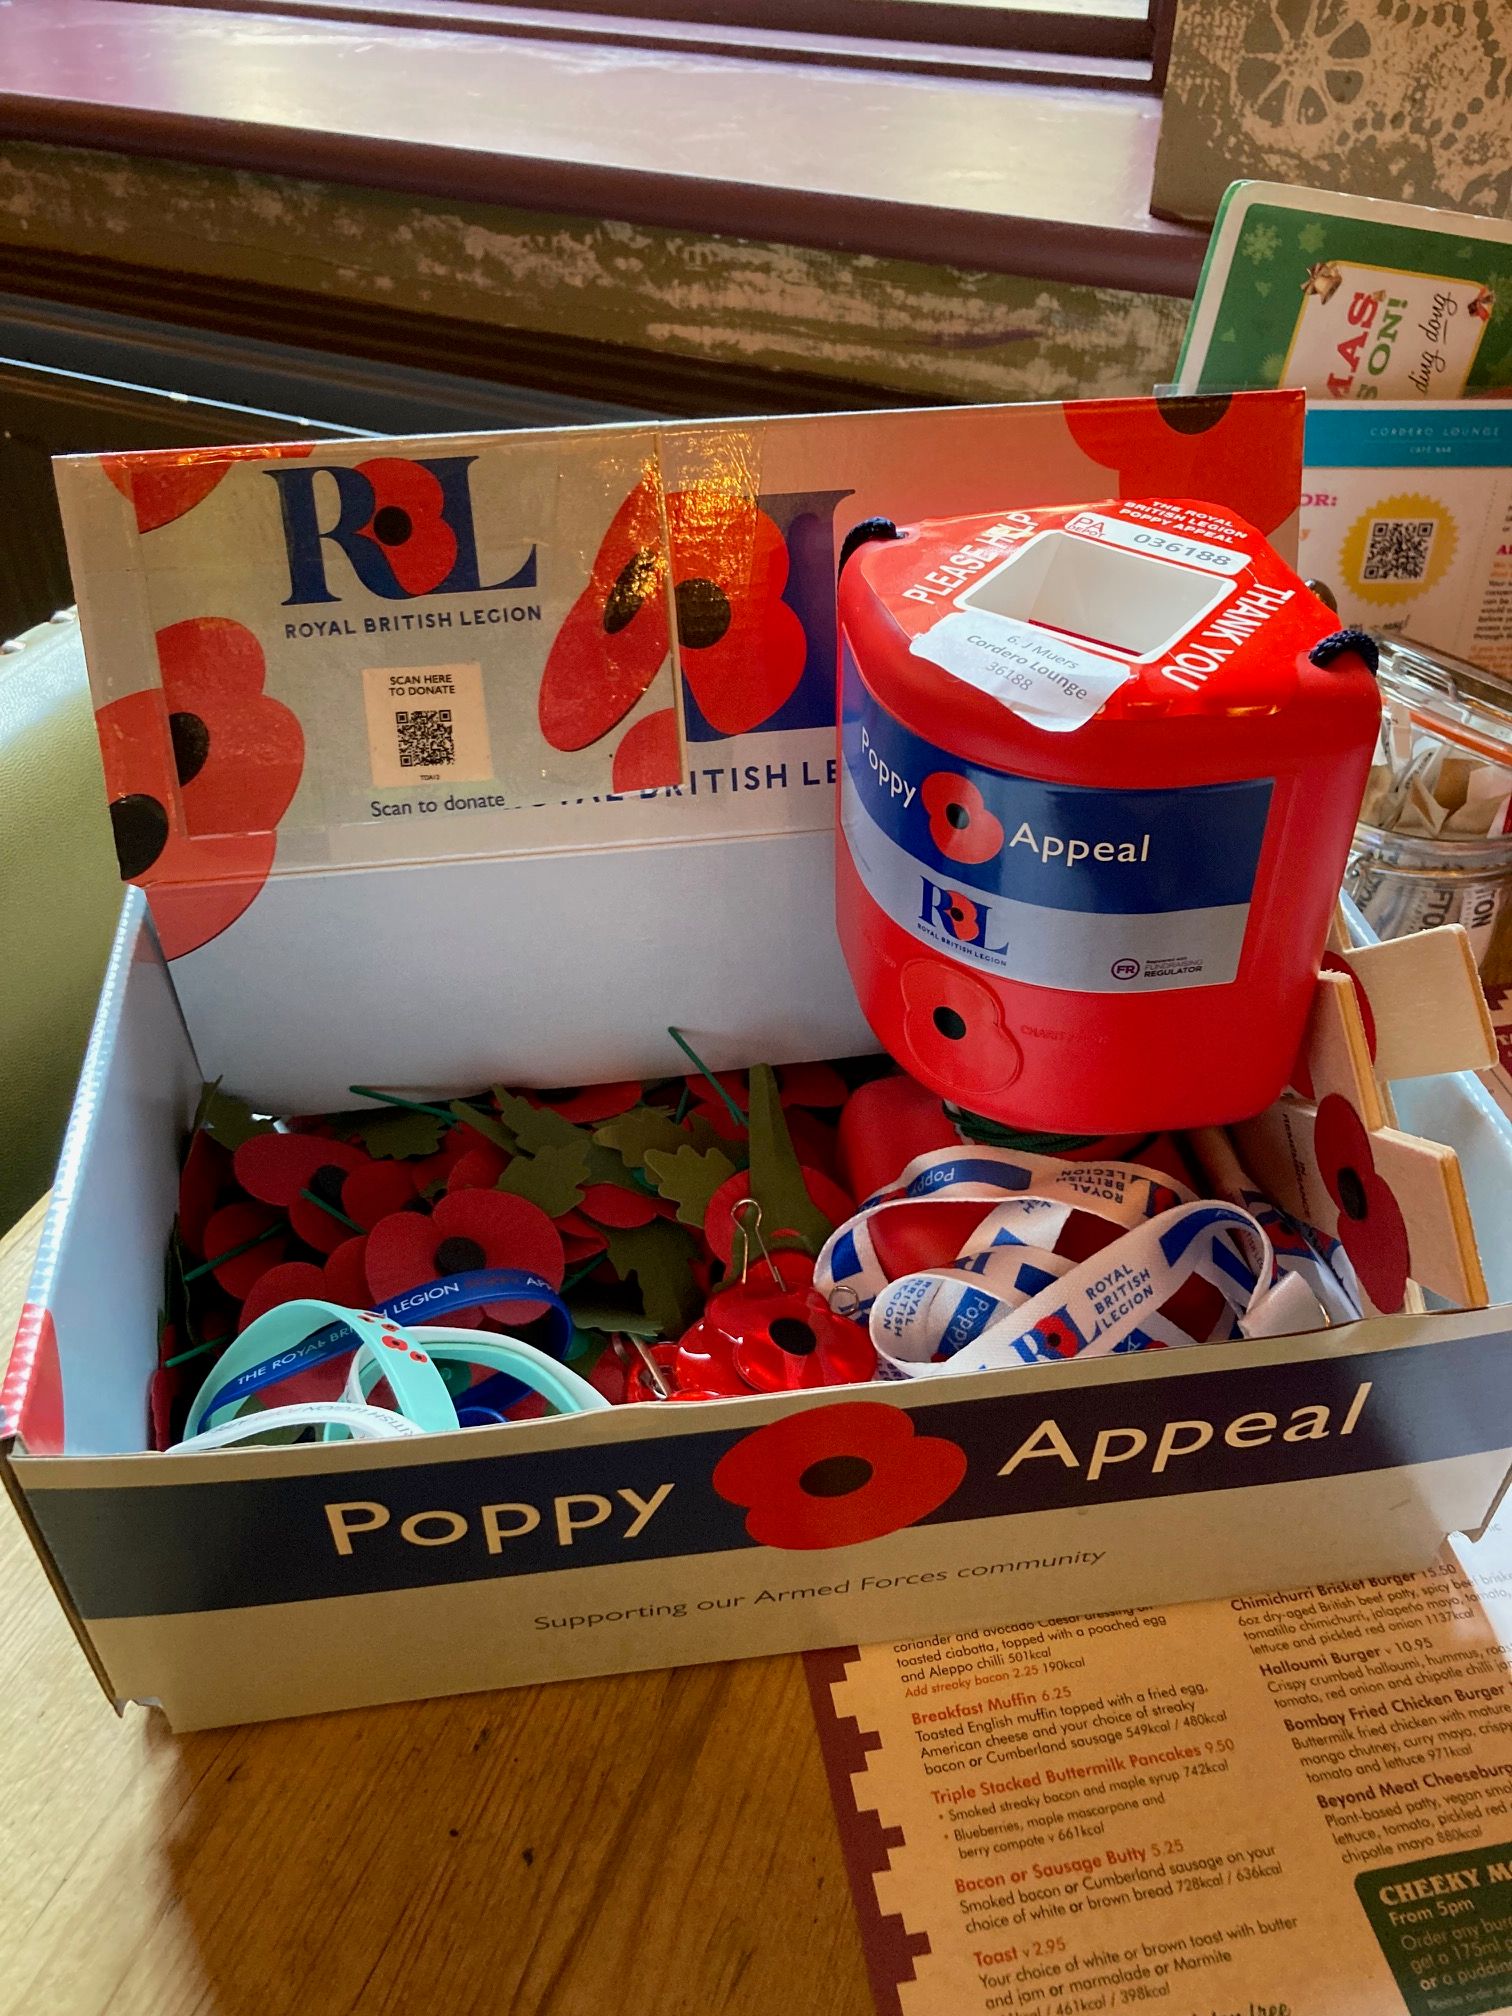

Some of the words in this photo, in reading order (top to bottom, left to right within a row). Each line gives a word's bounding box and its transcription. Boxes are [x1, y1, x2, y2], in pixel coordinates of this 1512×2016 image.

[1368, 298, 1408, 376] ON!
[1418, 292, 1458, 342] dong
[1408, 350, 1446, 394] ding
[1369, 425, 1434, 437] CORDERO
[1442, 425, 1501, 438] LOUNGE
[1119, 508, 1173, 526] POPPY
[1172, 523, 1234, 544] APPEAL
[1123, 501, 1187, 521] BRITISH
[1188, 519, 1248, 539] LEGION
[1153, 501, 1183, 512] THE
[1184, 510, 1233, 527] ROYAL
[1133, 533, 1232, 566] 036188
[901, 543, 993, 605] PLEASE
[285, 619, 357, 640] ROYAL
[364, 613, 453, 634] BRITISH
[460, 604, 542, 627] LEGION
[1202, 583, 1296, 646] THANK
[389, 676, 421, 686] SCAN
[424, 674, 453, 684] HERE
[966, 635, 1029, 665] Cordero
[1030, 661, 1088, 700] Lounge
[987, 661, 1033, 691] 36188
[1160, 642, 1235, 692] YOU
[389, 687, 406, 696] TO
[408, 685, 456, 696] DONATE
[370, 800, 412, 818] Scan
[420, 801, 438, 815] to
[444, 794, 505, 813] donate
[861, 726, 917, 809] Poppy
[1009, 822, 1151, 867] Appeal
[917, 923, 940, 940] ROYAL
[941, 937, 973, 955] BRITISH
[974, 950, 1007, 967] LEGION
[1144, 966, 1203, 978] REGULATOR
[1056, 1176, 1125, 1191] BRITISH
[1061, 1169, 1126, 1180] LEGION
[1070, 1183, 1123, 1204] ROYAL
[1086, 1264, 1135, 1300] ROYAL
[1094, 1268, 1151, 1315] BRITISH
[894, 1280, 924, 1337] BRITISH
[905, 1281, 932, 1326] ROYAL
[1102, 1285, 1154, 1329] LEGION
[237, 1366, 266, 1385] THE
[272, 1340, 326, 1370] ROYAL
[394, 1282, 460, 1314] LEGION
[324, 1483, 676, 1556] Poppy
[998, 1381, 1373, 1480] Appeal
[534, 1602, 687, 1631] Supporting
[696, 1595, 745, 1612] our
[754, 1579, 851, 1606] Armed
[860, 1570, 948, 1593] Forces
[957, 1550, 1107, 1580] community
[1230, 1590, 1314, 1612] Chimichurri
[1316, 1580, 1366, 1597] Brisket
[1367, 1572, 1416, 1589] Burger
[893, 1635, 951, 1653] coriander
[956, 1629, 979, 1643] and
[983, 1620, 1036, 1637] avocado
[896, 1651, 942, 1668] toasted
[945, 1640, 999, 1659] ciabatta,
[1001, 1631, 1045, 1651] topped
[1047, 1628, 1073, 1642] with
[1076, 1628, 1085, 1638] a
[1087, 1616, 1140, 1640] poached
[1142, 1614, 1168, 1629] egg
[900, 1669, 926, 1683] and
[929, 1660, 974, 1680] Aleppo
[976, 1653, 1005, 1669] chilli
[1008, 1647, 1052, 1664] 501kcal
[1259, 1657, 1328, 1677] Halloumi
[1330, 1647, 1381, 1665] Burger
[1395, 1637, 1434, 1653] 10.95
[904, 1685, 928, 1698] Add
[931, 1677, 972, 1694] streaky
[974, 1671, 1010, 1687] bacon
[1013, 1664, 1039, 1678] 2.25
[1042, 1657, 1086, 1675] 190kcal
[912, 1702, 984, 1725] Breakfast
[988, 1694, 1038, 1711] Muffin
[1042, 1687, 1073, 1701] 6.25
[915, 1726, 964, 1743] Toasted
[968, 1716, 1014, 1735] English
[1017, 1708, 1058, 1725] muffin
[1060, 1699, 1105, 1718] topped
[1108, 1693, 1134, 1707] with
[1136, 1693, 1145, 1702] a
[1148, 1684, 1177, 1700] fried
[1180, 1682, 1208, 1697] egg,
[1283, 1713, 1346, 1732] Bombay
[1348, 1703, 1389, 1721] Fried
[1391, 1692, 1453, 1713] Chicken
[1454, 1684, 1505, 1703] Burger
[920, 1741, 982, 1759] American
[985, 1731, 1029, 1748] cheese
[1032, 1724, 1058, 1739] and
[1060, 1718, 1090, 1735] your
[1092, 1711, 1132, 1728] choice
[1136, 1705, 1150, 1719] of
[1152, 1700, 1196, 1717] streaky
[924, 1759, 966, 1775] bacon
[969, 1757, 983, 1768] or
[986, 1740, 1068, 1764] Cumberland
[1070, 1731, 1123, 1751] sausage
[1126, 1720, 1171, 1739] 549kcal
[930, 1787, 976, 1805] Triple
[980, 1773, 1042, 1797] Stacked
[1045, 1758, 1127, 1784] Buttermilk
[1130, 1746, 1202, 1770] Pancakes
[1204, 1738, 1235, 1753] 9.50
[1316, 1785, 1377, 1809] Beyond
[1378, 1779, 1420, 1798] Meat
[954, 1875, 1006, 1894] Bacon
[1010, 1868, 1029, 1882] or
[1032, 1855, 1103, 1879] Sausage
[1105, 1848, 1147, 1868] Butty
[1150, 1839, 1184, 1857] 5.25
[1379, 1868, 1481, 1906] CHEEKY
[1388, 1907, 1434, 1926] From
[1436, 1898, 1475, 1917] 5pm
[973, 1947, 1018, 1967] Toast
[1032, 1937, 1066, 1956] 2.95
